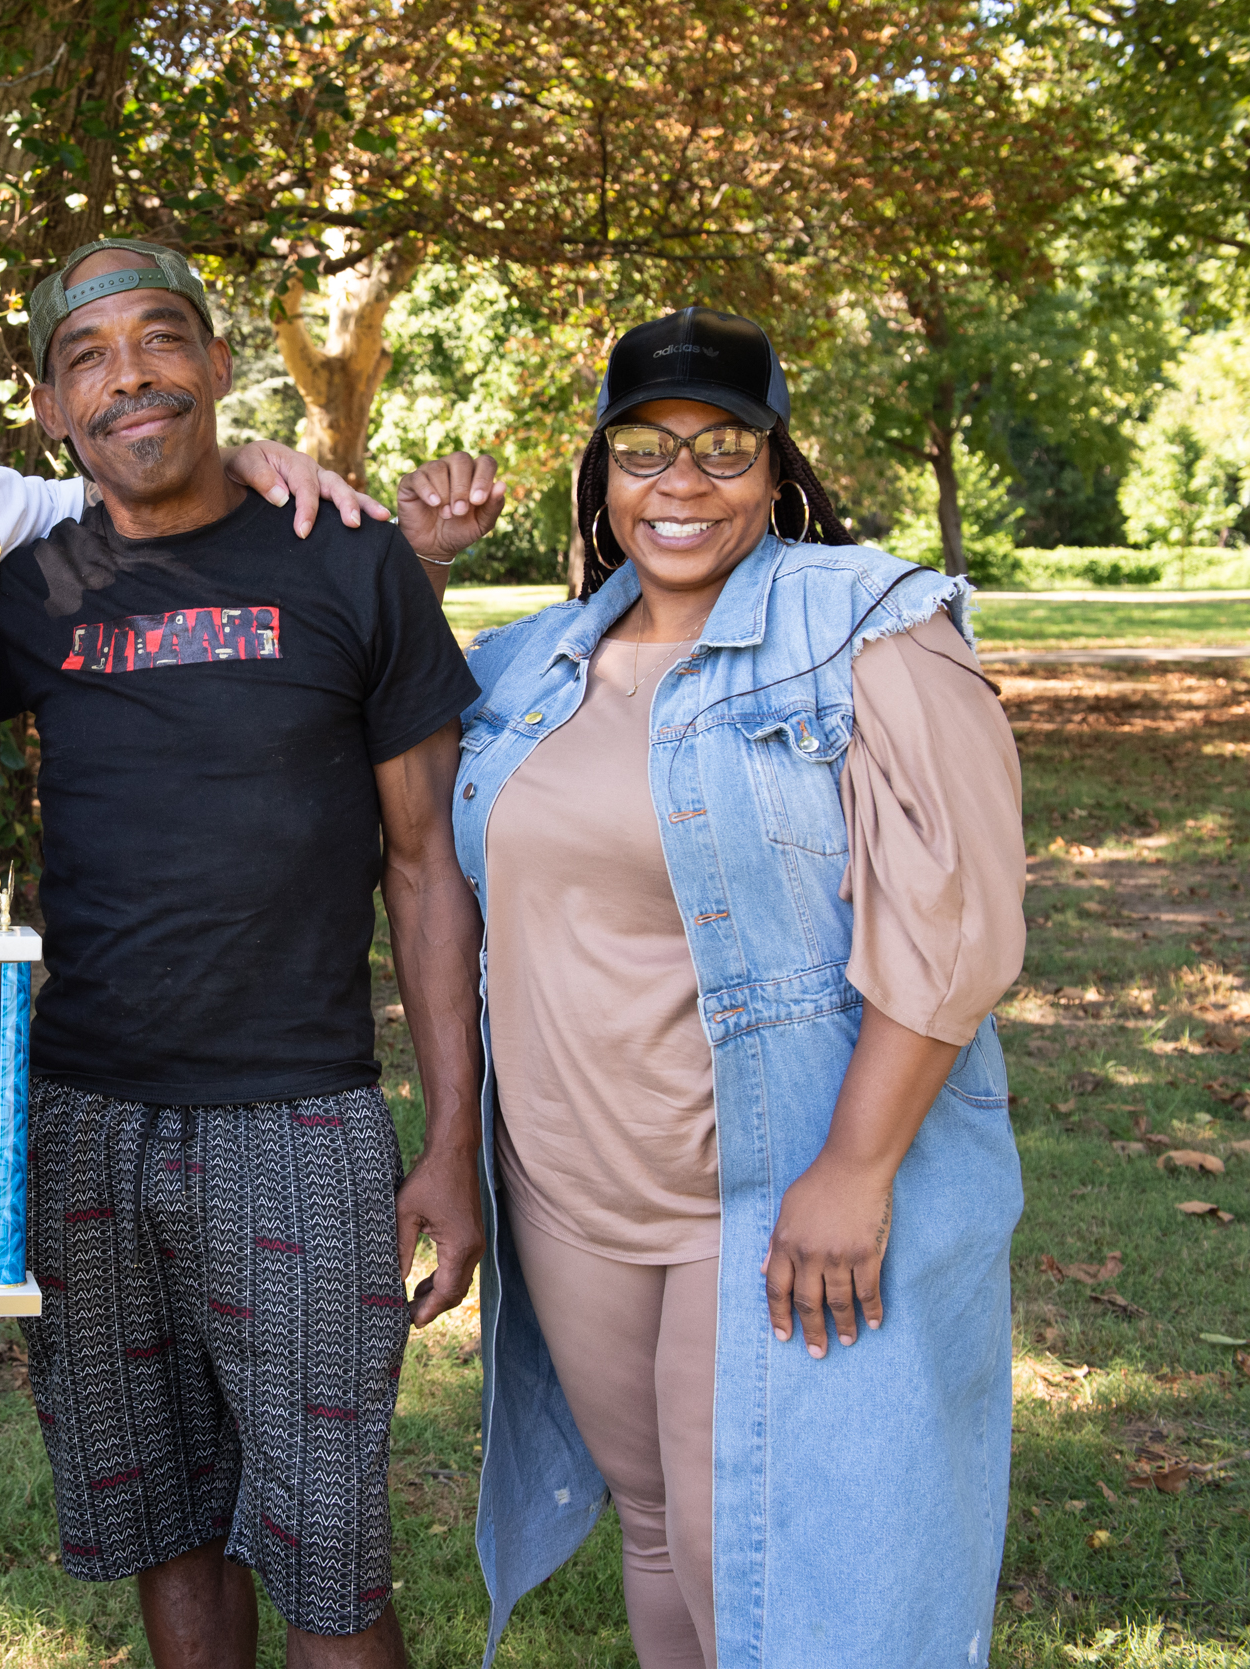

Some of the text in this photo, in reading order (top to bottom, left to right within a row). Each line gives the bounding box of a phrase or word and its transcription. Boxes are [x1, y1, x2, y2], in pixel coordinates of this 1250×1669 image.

[652, 343, 700, 359] adidas
[292, 1112, 343, 1126] SAVAGE
[65, 1208, 114, 1222] SAVAGE
[307, 1404, 357, 1420] SAVAGE
[91, 1466, 143, 1491] SAVAGE
